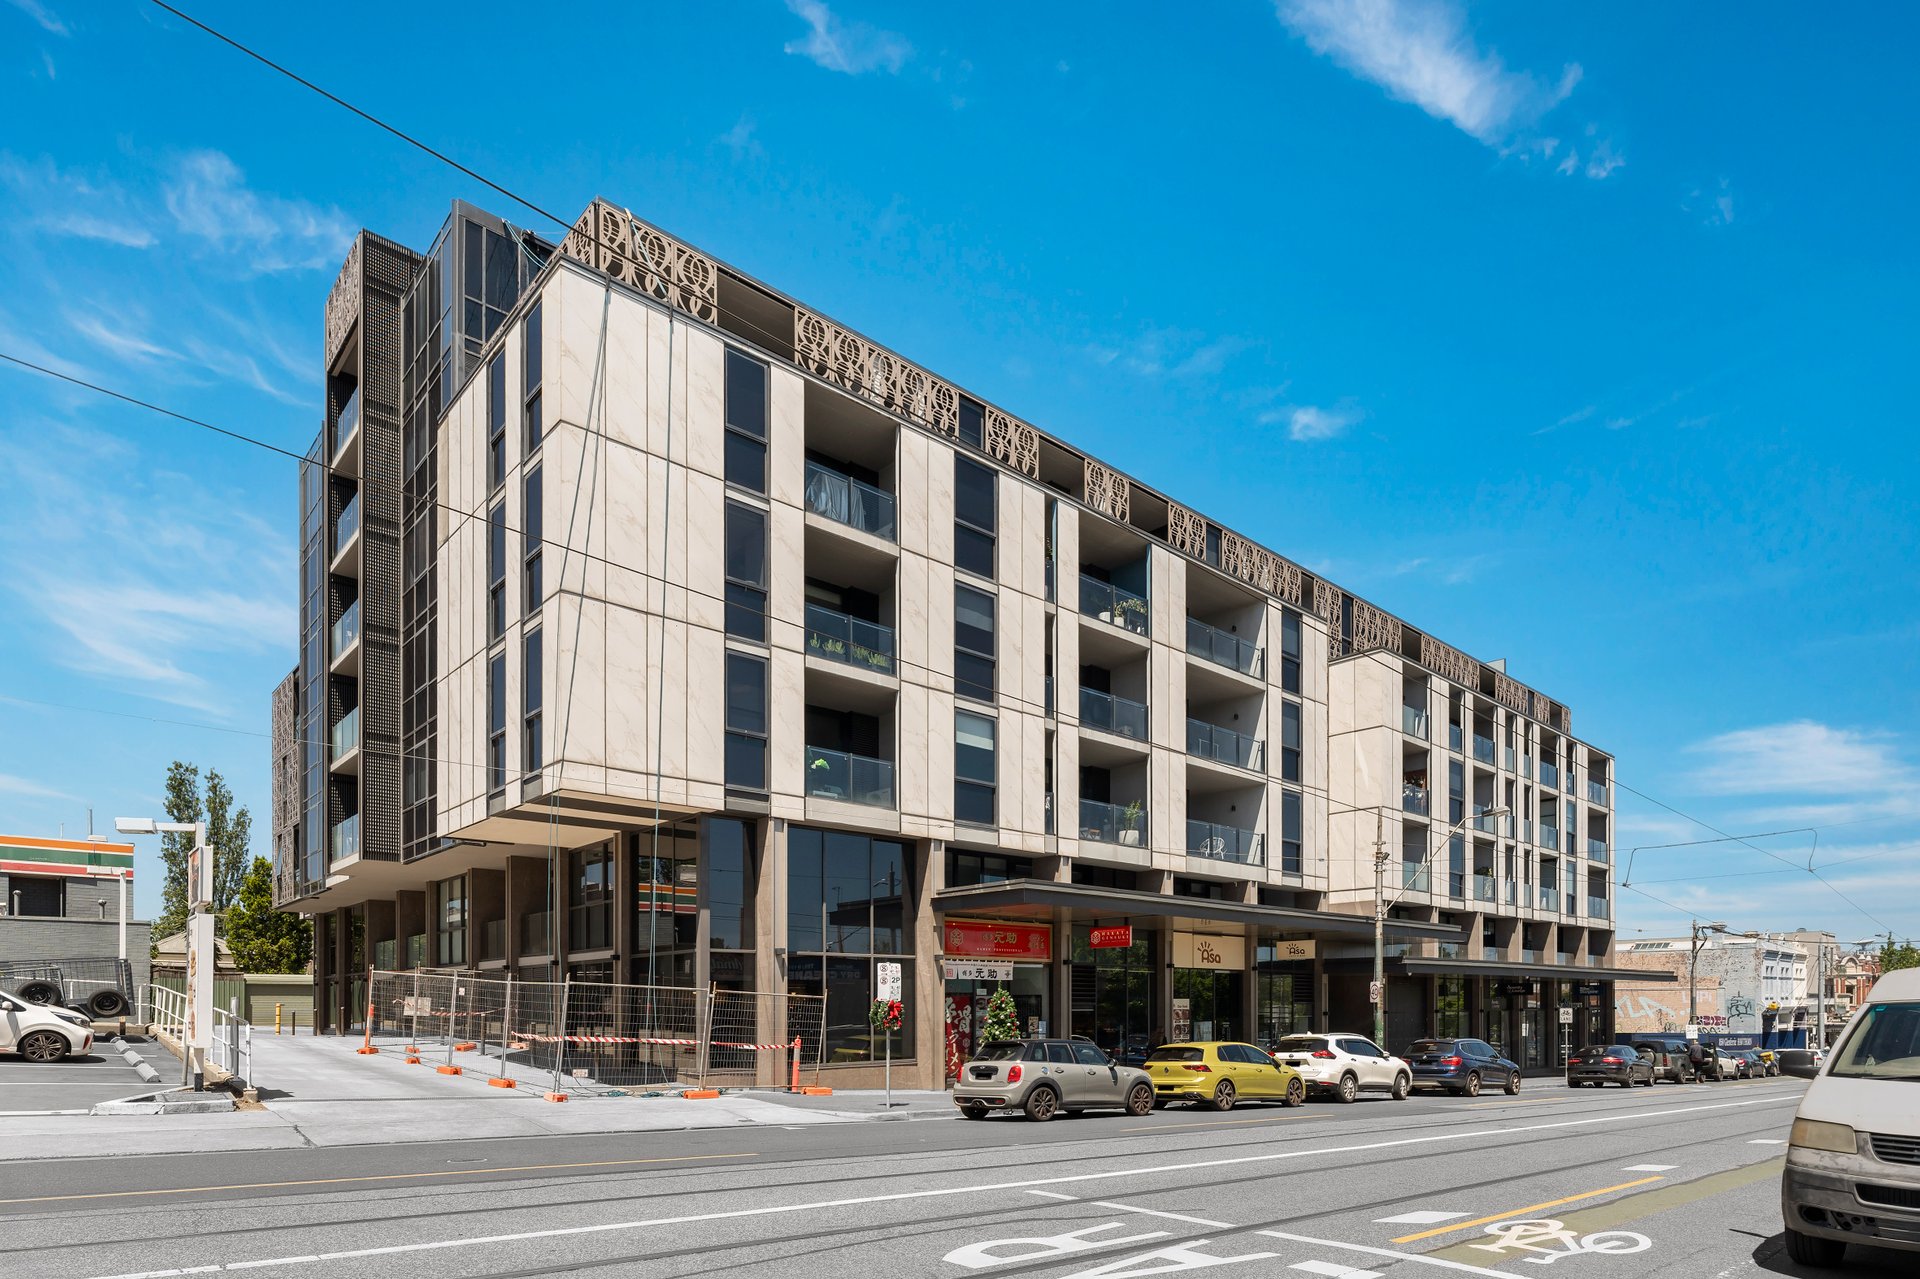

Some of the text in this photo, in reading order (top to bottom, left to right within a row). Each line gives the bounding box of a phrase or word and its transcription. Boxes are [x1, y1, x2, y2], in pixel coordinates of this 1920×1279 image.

[1289, 947, 1305, 955] Asa
[1201, 949, 1221, 964] Asa
[891, 976, 901, 984] 2P
